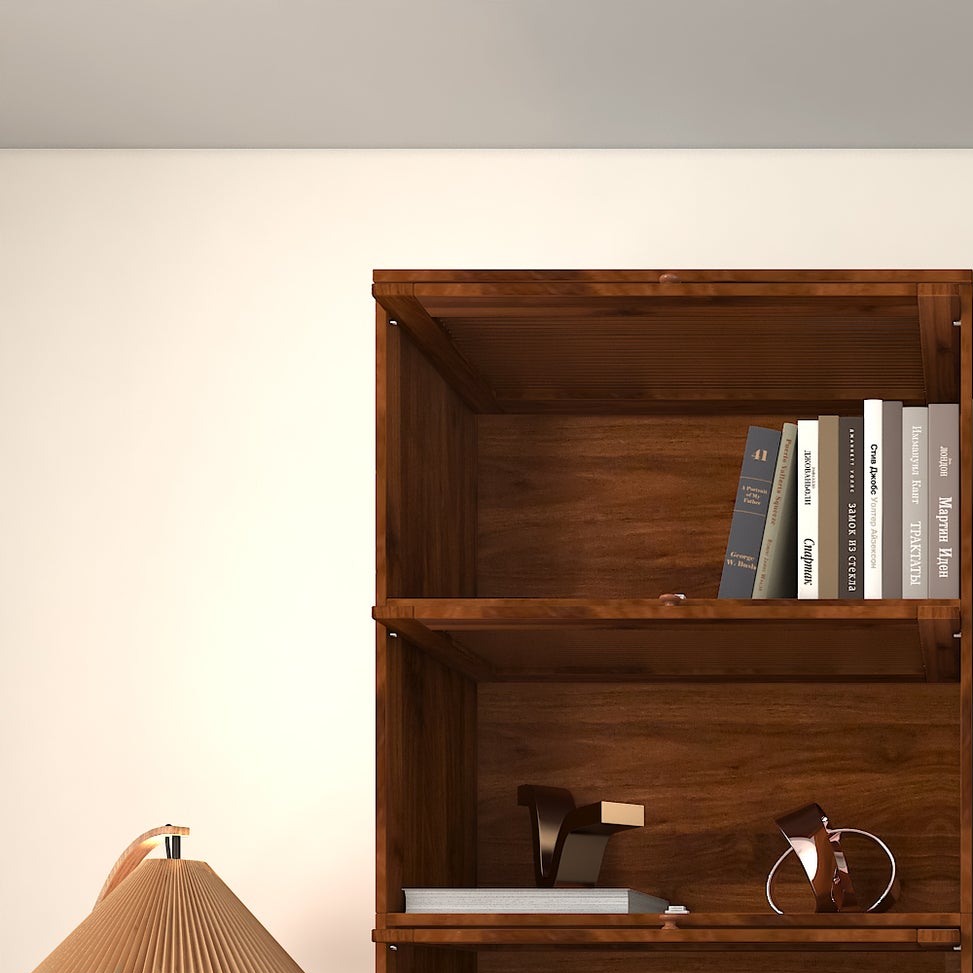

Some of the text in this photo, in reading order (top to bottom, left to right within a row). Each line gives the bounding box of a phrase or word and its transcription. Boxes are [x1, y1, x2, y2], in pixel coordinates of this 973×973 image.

[752, 449, 767, 462] 41
[868, 444, 878, 495] Стив Джобс
[910, 426, 921, 504] Иммануил Кант
[730, 551, 754, 562] George
[868, 497, 879, 569] Уолтер Айзексон
[910, 521, 921, 586] ТРАКТАТЫ
[936, 497, 952, 578] Мартин Иден
[727, 559, 756, 570] W. Bush
[801, 539, 815, 586] Спартак
